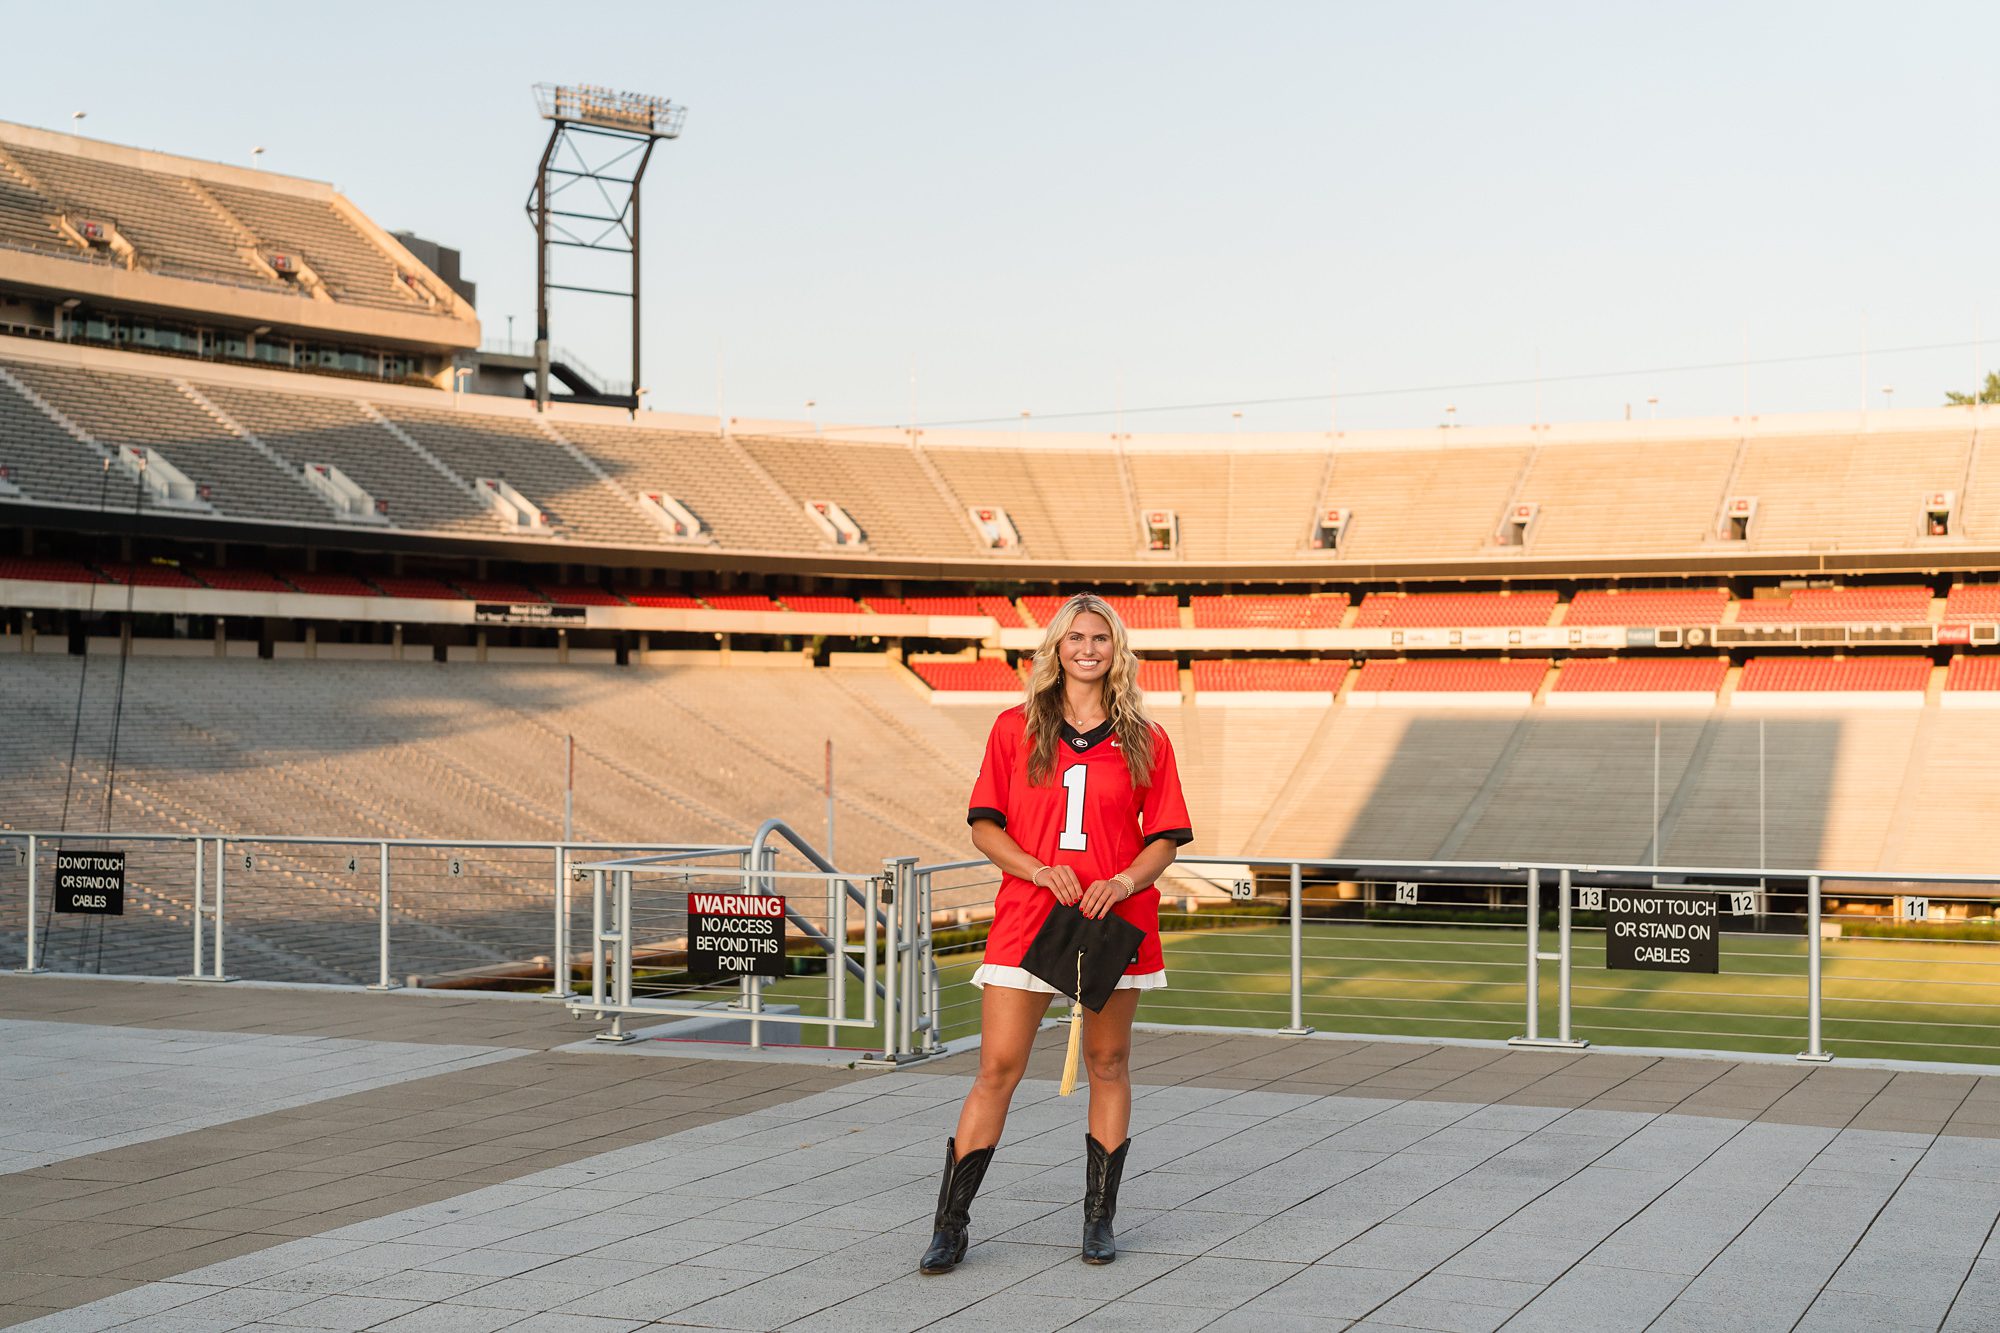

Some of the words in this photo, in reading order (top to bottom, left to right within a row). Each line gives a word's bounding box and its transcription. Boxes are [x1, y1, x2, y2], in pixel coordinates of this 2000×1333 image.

[1059, 764, 1088, 851] 1
[20, 851, 26, 863] 7
[58, 856, 72, 869] DO
[73, 857, 92, 870] NOT
[93, 858, 123, 871] TOUCH
[245, 856, 252, 869] 5
[349, 860, 355, 871] 4
[453, 862, 460, 874] 3
[61, 875, 75, 888] OR
[76, 876, 104, 889] STAND
[105, 877, 119, 890] ON
[1234, 881, 1251, 896] 15
[72, 894, 107, 908] CABLES
[1398, 885, 1415, 901] 14
[1581, 891, 1599, 906] 13
[694, 894, 781, 916] WARNING
[1609, 897, 1631, 913] DO
[1634, 899, 1664, 915] NOT
[1665, 899, 1716, 917] TOUCH
[1733, 895, 1753, 912] 12
[1907, 901, 1924, 917] 11
[701, 917, 721, 932] NO
[721, 918, 773, 934] ACCESS
[1614, 921, 1637, 938] OR
[1639, 923, 1686, 939] STAND
[1688, 925, 1710, 941] ON
[697, 936, 749, 952] BEYOND
[749, 938, 778, 954] THIS
[1634, 946, 1691, 964] CABLES
[718, 956, 756, 972] POINT
